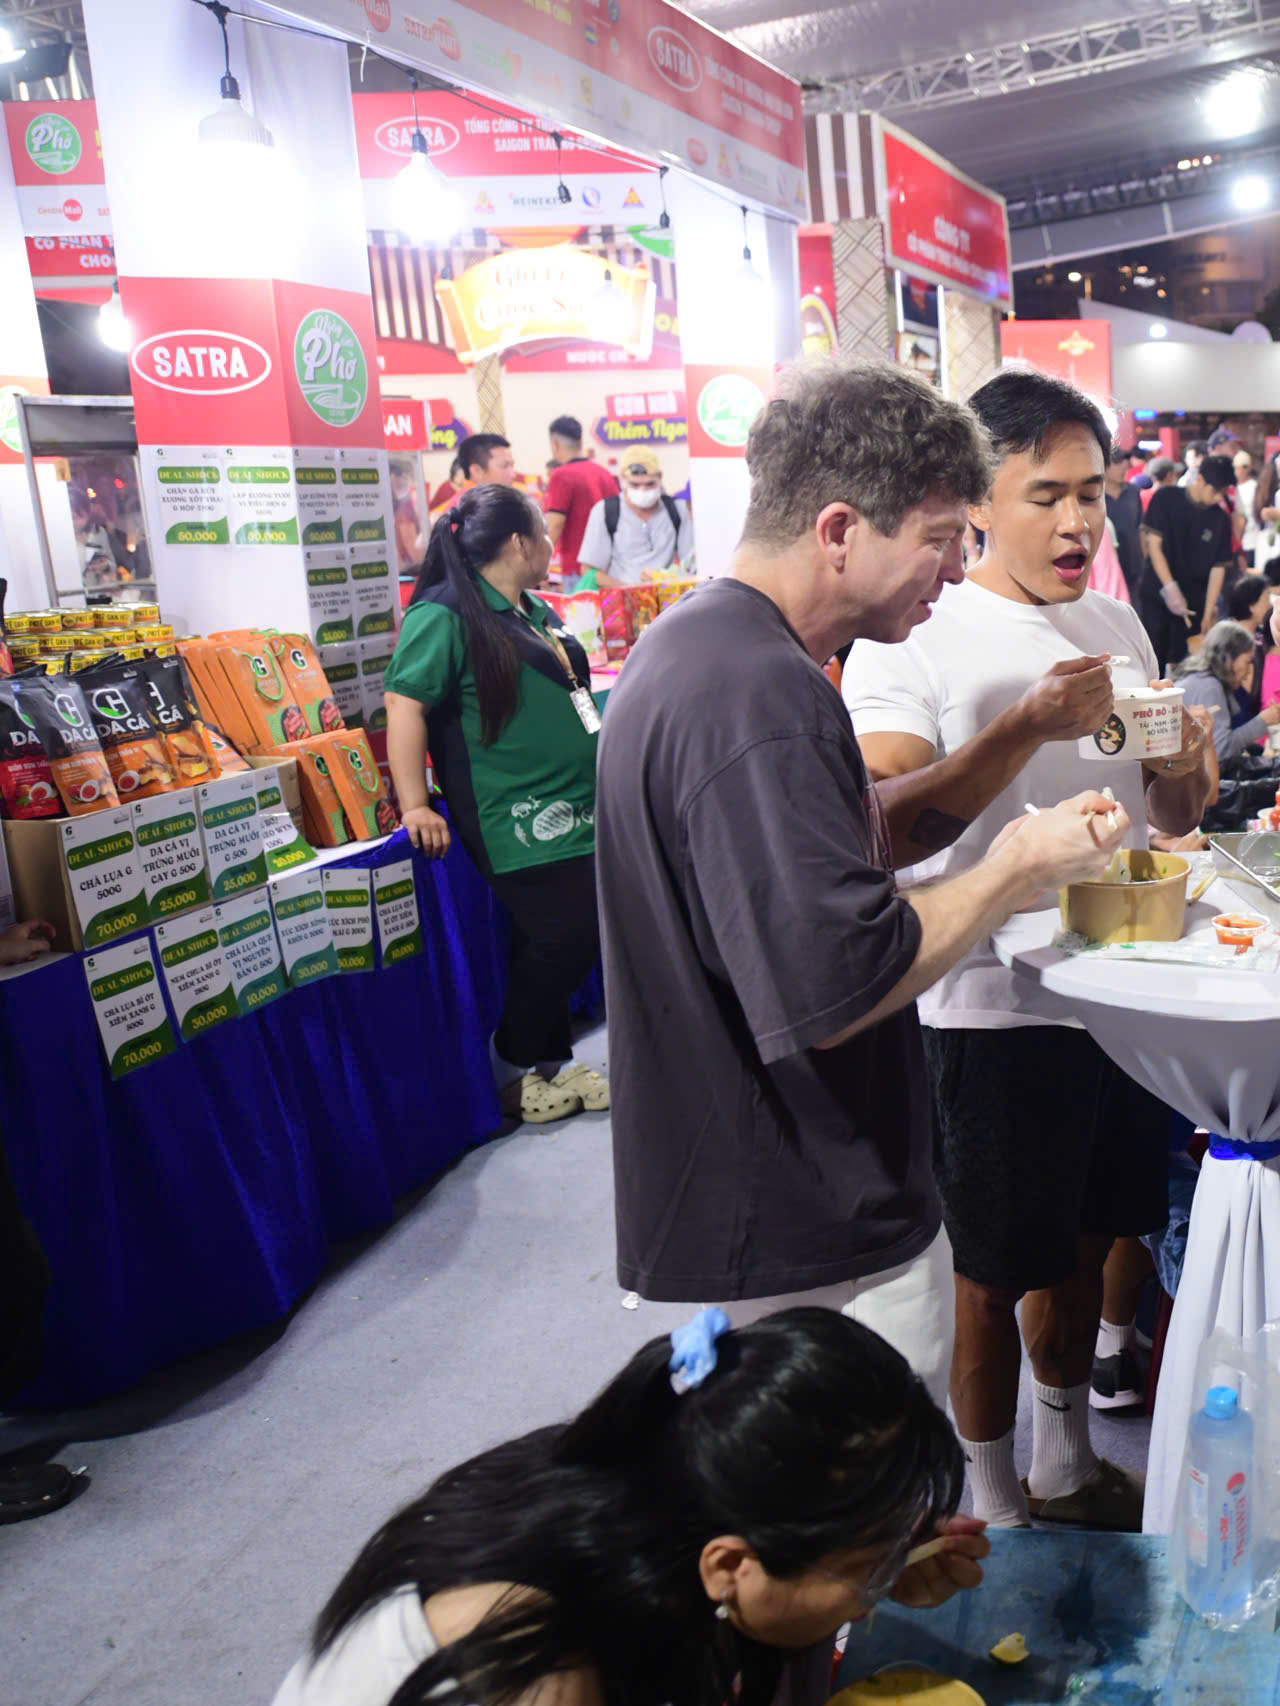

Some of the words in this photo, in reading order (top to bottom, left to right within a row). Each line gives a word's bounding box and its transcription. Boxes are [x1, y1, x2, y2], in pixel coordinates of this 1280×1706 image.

[656, 38, 694, 82] SATRA
[387, 126, 445, 148] SARA
[512, 195, 563, 208] HEINEKE
[153, 346, 249, 379] SATRA
[302, 327, 359, 382] Phở
[126, 712, 150, 731] CÁ
[158, 704, 184, 724] CÁ
[1132, 707, 1153, 718] PHỞ
[9, 730, 41, 746] DA
[227, 802, 256, 817] SHOCK
[164, 817, 195, 834] SHOCK
[69, 848, 96, 865] DEAL
[98, 836, 133, 857] SHOCK
[150, 845, 163, 858] DA
[179, 837, 189, 850] VỊ
[143, 856, 174, 873] TRỨNG
[177, 847, 200, 862] MUỐI
[80, 875, 101, 892] CHẢ
[103, 870, 124, 887] LỤA
[125, 866, 133, 875] G
[151, 871, 169, 885] CAY
[171, 868, 178, 878] G
[180, 862, 196, 876] 50G
[97, 884, 122, 900] 500G
[159, 889, 197, 911] 25,000
[96, 912, 137, 937] 70,000
[187, 935, 217, 952] SHOCK
[120, 967, 153, 985] SHOCK
[129, 1006, 149, 1021] XANH
[123, 1041, 162, 1066] 70,000
